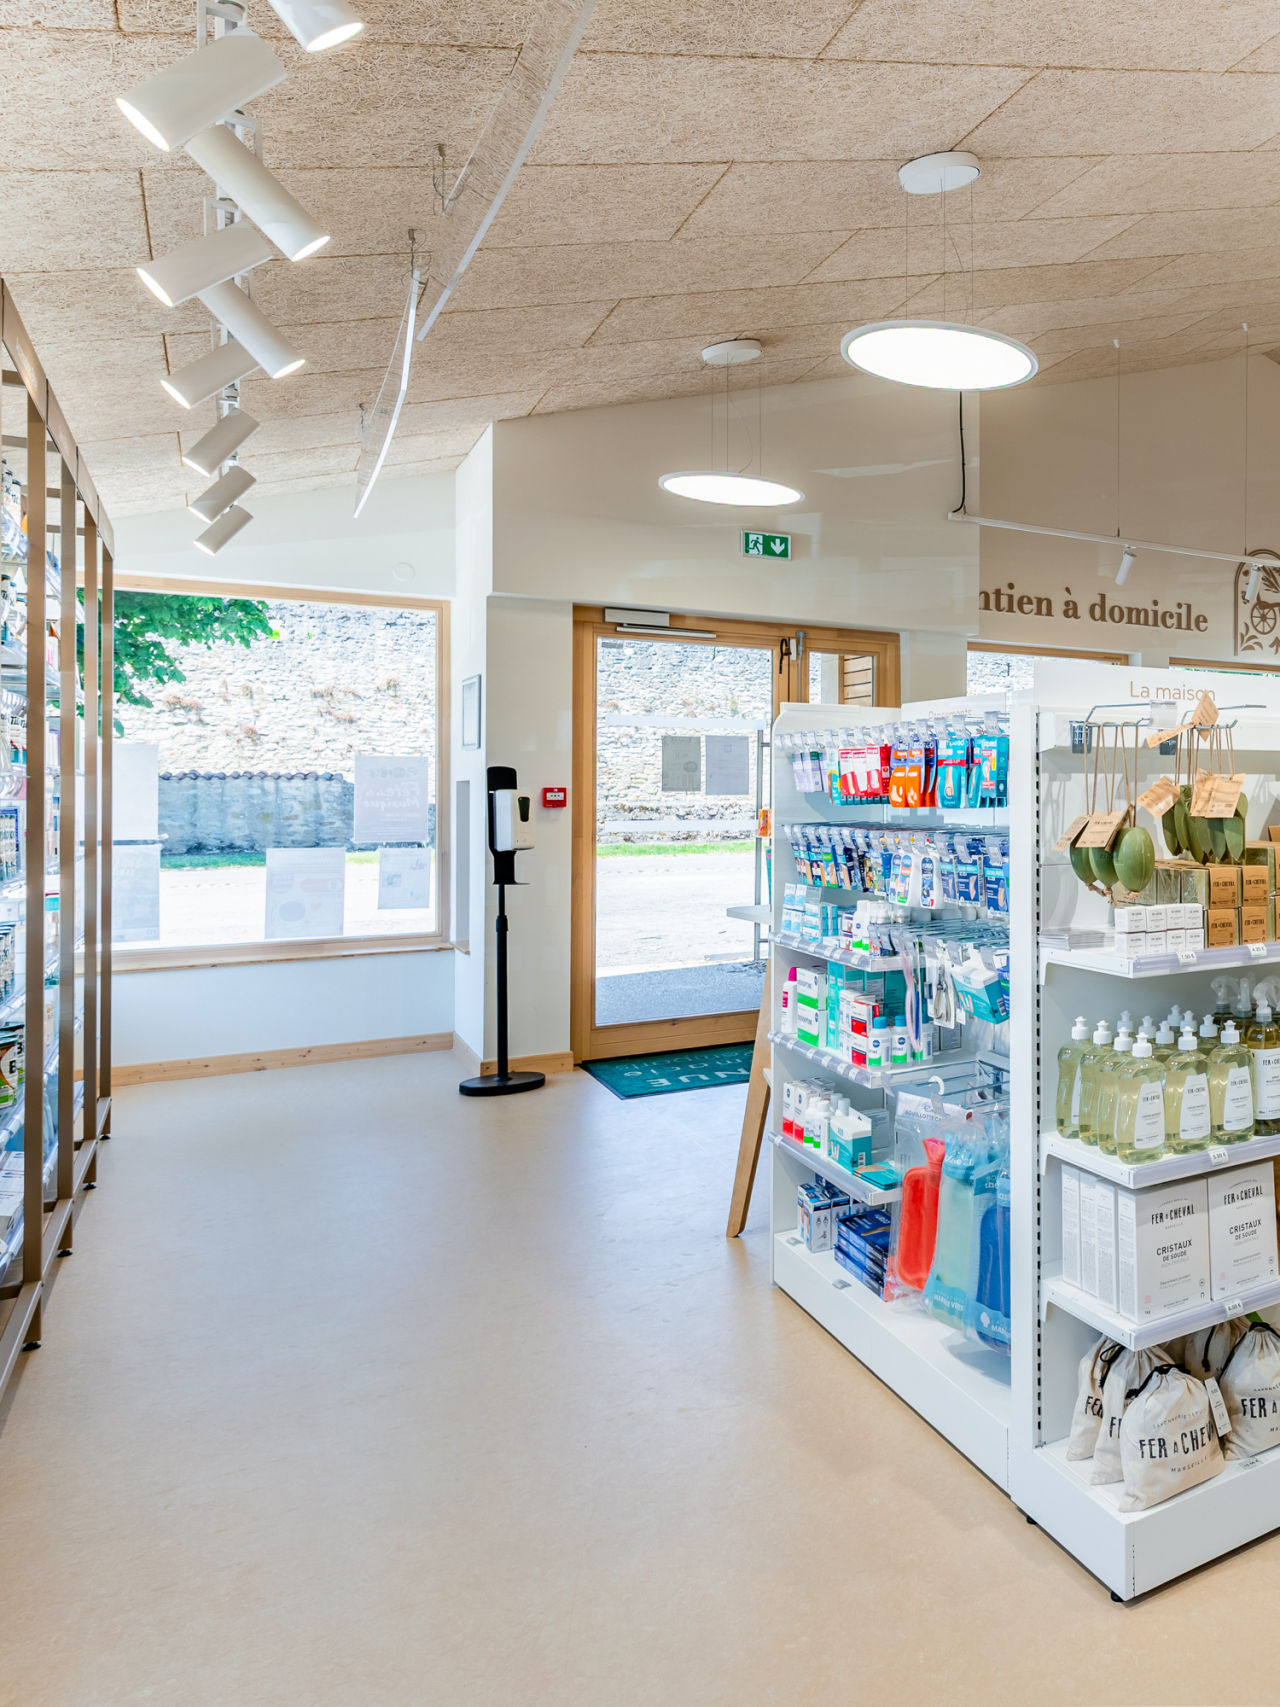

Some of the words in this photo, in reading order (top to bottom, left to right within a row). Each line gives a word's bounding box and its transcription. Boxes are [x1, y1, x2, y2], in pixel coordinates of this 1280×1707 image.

[979, 583, 1054, 617] ntien
[1063, 587, 1081, 619] à
[1089, 593, 1208, 632] domicile
[1130, 681, 1149, 698] La
[1156, 684, 1215, 701] maison
[1224, 1193, 1236, 1205] FER
[1240, 1185, 1263, 1201] CHEVAL
[1151, 1212, 1164, 1225] FER
[1169, 1204, 1195, 1221] CHEVAL
[1229, 1218, 1262, 1235] CRISTAUX
[1235, 1233, 1241, 1241] DE
[1242, 1229, 1257, 1239] SOUDE
[1156, 1239, 1193, 1256] CRISTAUX
[1162, 1254, 1169, 1262] DE
[1170, 1250, 1187, 1260] SOUDE
[1241, 1397, 1267, 1419] FER
[1272, 1400, 1278, 1414] À
[1152, 1414, 1187, 1430] SAVONNERIE
[1188, 1407, 1207, 1419] DEPUIS
[1139, 1438, 1168, 1459] FER
[1173, 1440, 1179, 1454] À
[1181, 1420, 1214, 1455] CHEV
[1171, 1455, 1208, 1473] MARSEILLE
